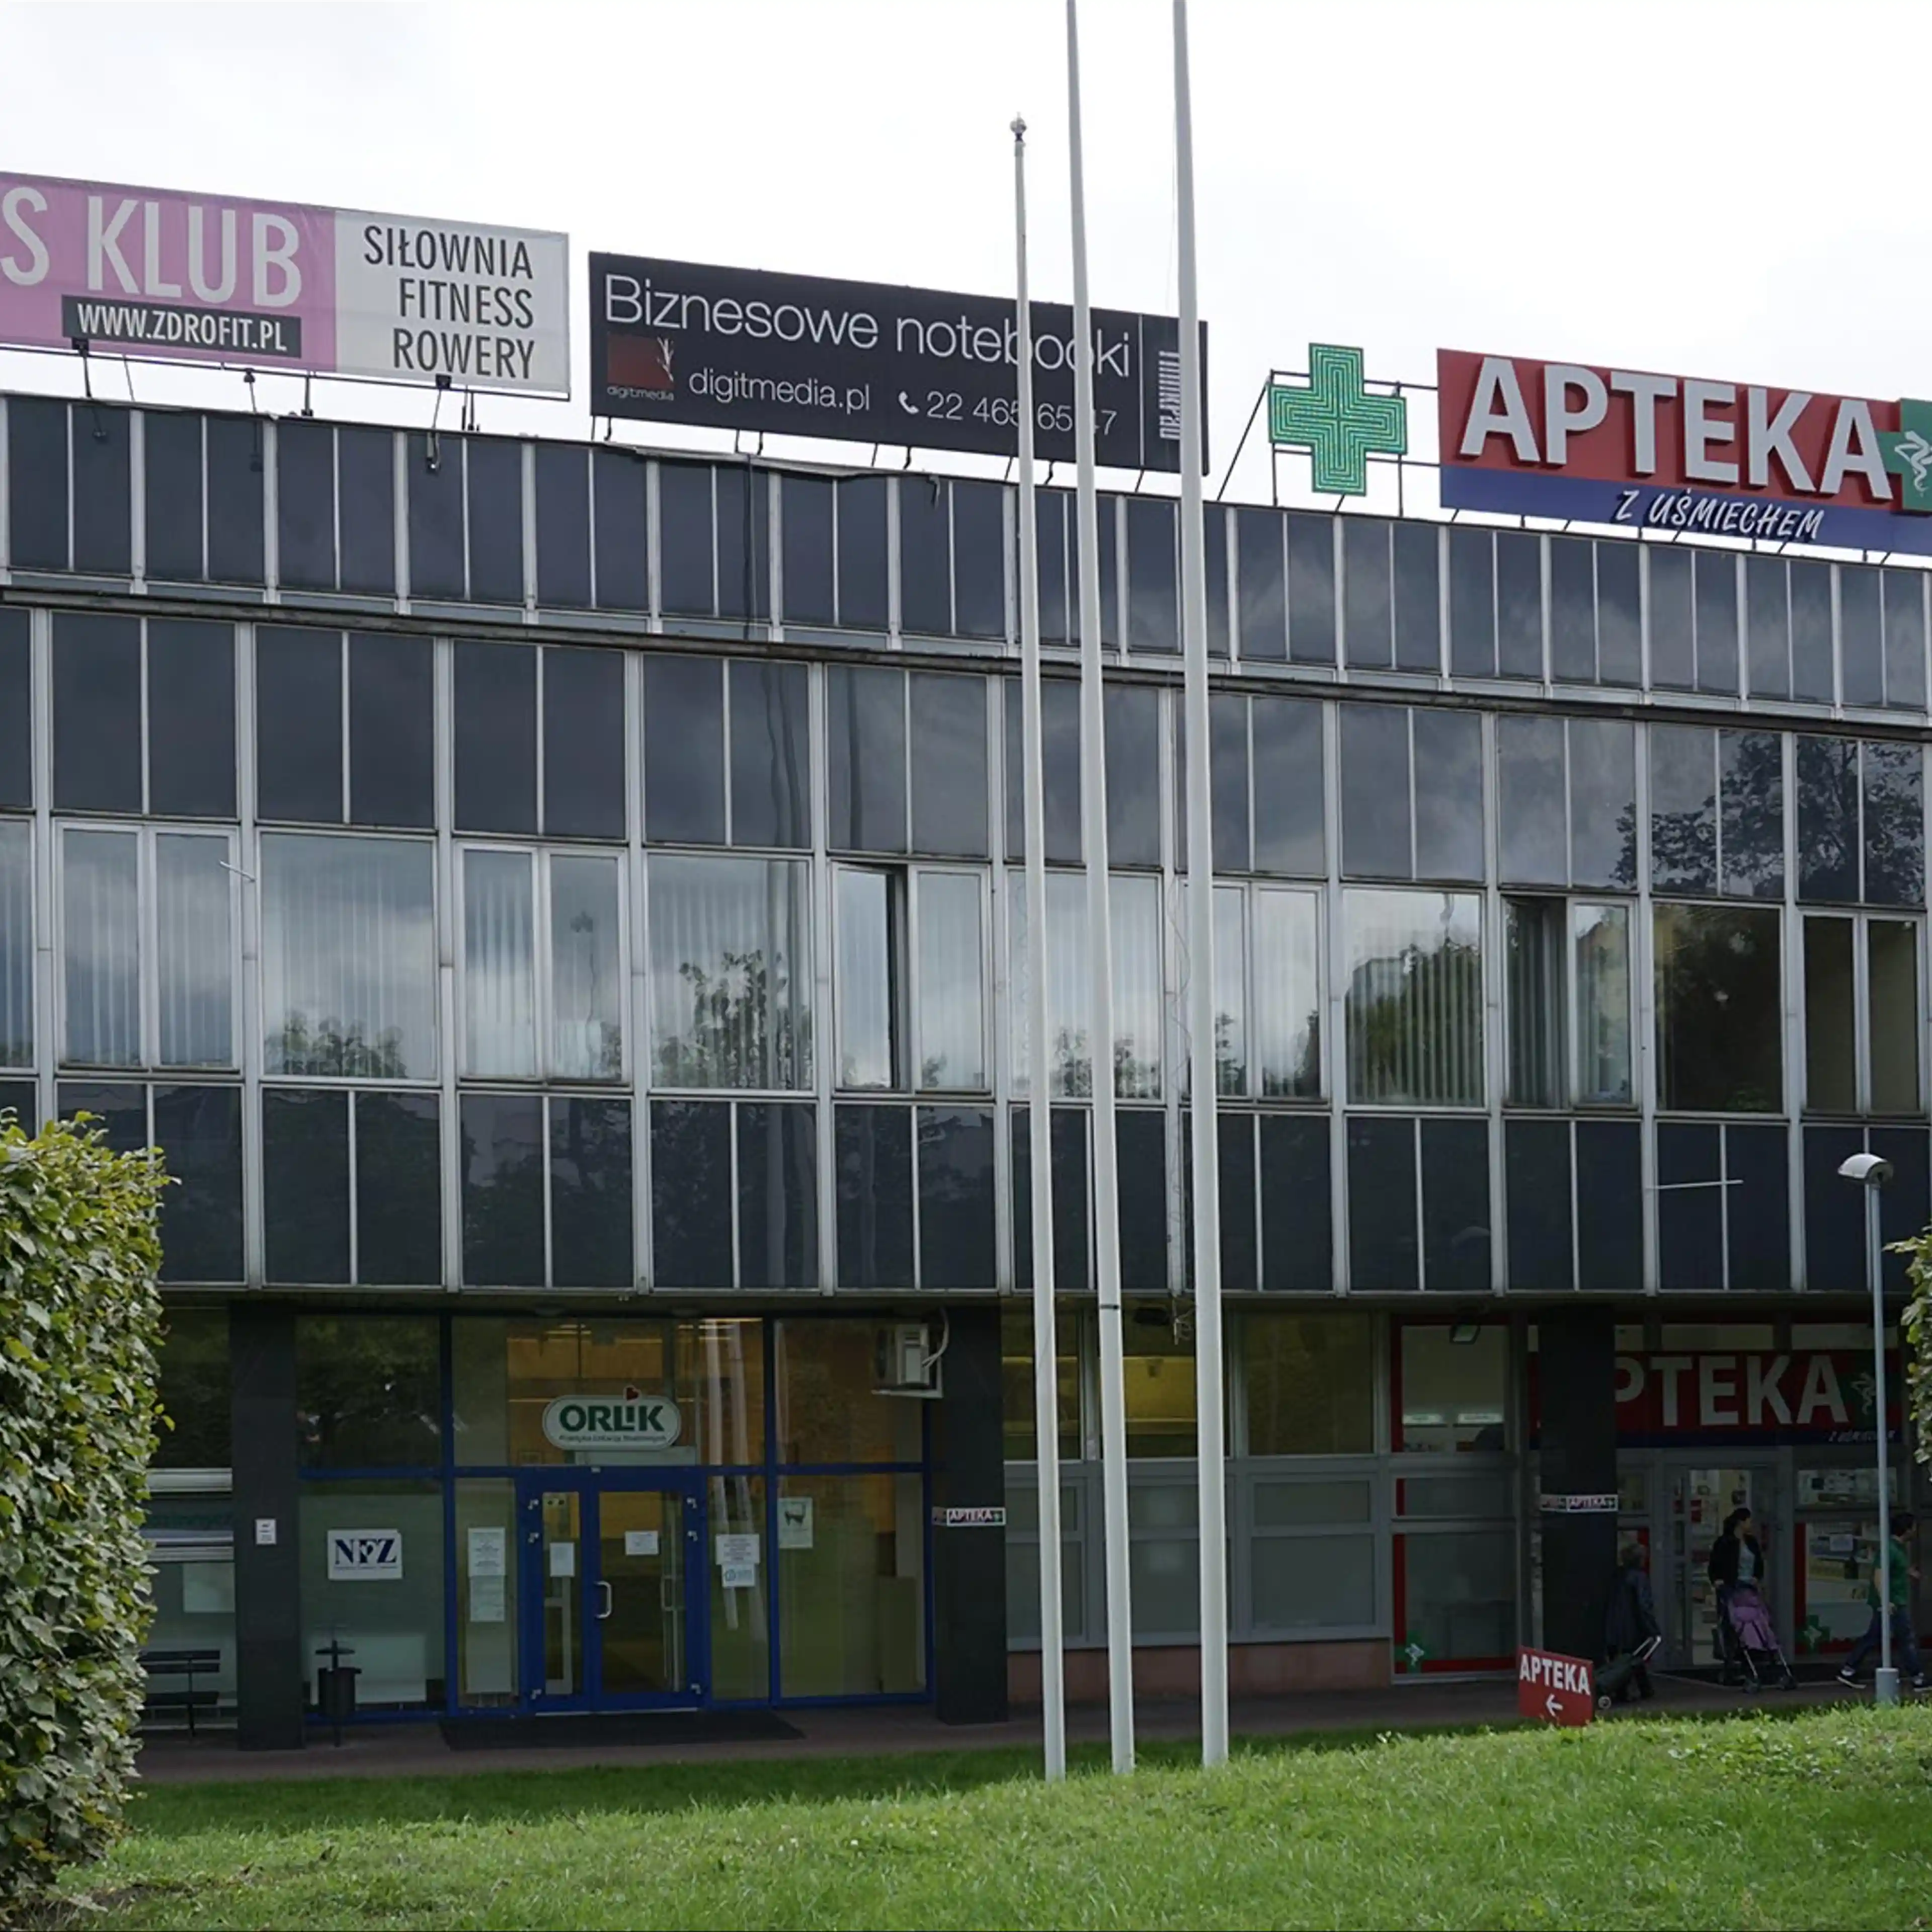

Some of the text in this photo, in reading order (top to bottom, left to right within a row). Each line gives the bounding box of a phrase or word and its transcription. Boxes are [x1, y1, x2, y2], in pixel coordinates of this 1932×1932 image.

[87, 196, 302, 308] KLUB
[364, 225, 533, 279] SIŁOWNIA
[77, 303, 287, 351] WWW.ZDROFIT.PL
[399, 277, 534, 329] FITNESS
[605, 274, 878, 349] Biznesowe
[393, 328, 535, 379] ROWERY
[689, 367, 869, 414] digitmedia.pl
[927, 391, 963, 420] 22
[1038, 404, 1072, 432] 65
[1460, 356, 1892, 499] APTEKA
[1649, 488, 1824, 539] UŚMIECHEM
[1616, 1355, 1848, 1426] PTEKA
[1519, 1654, 1591, 1695] APTEKA
